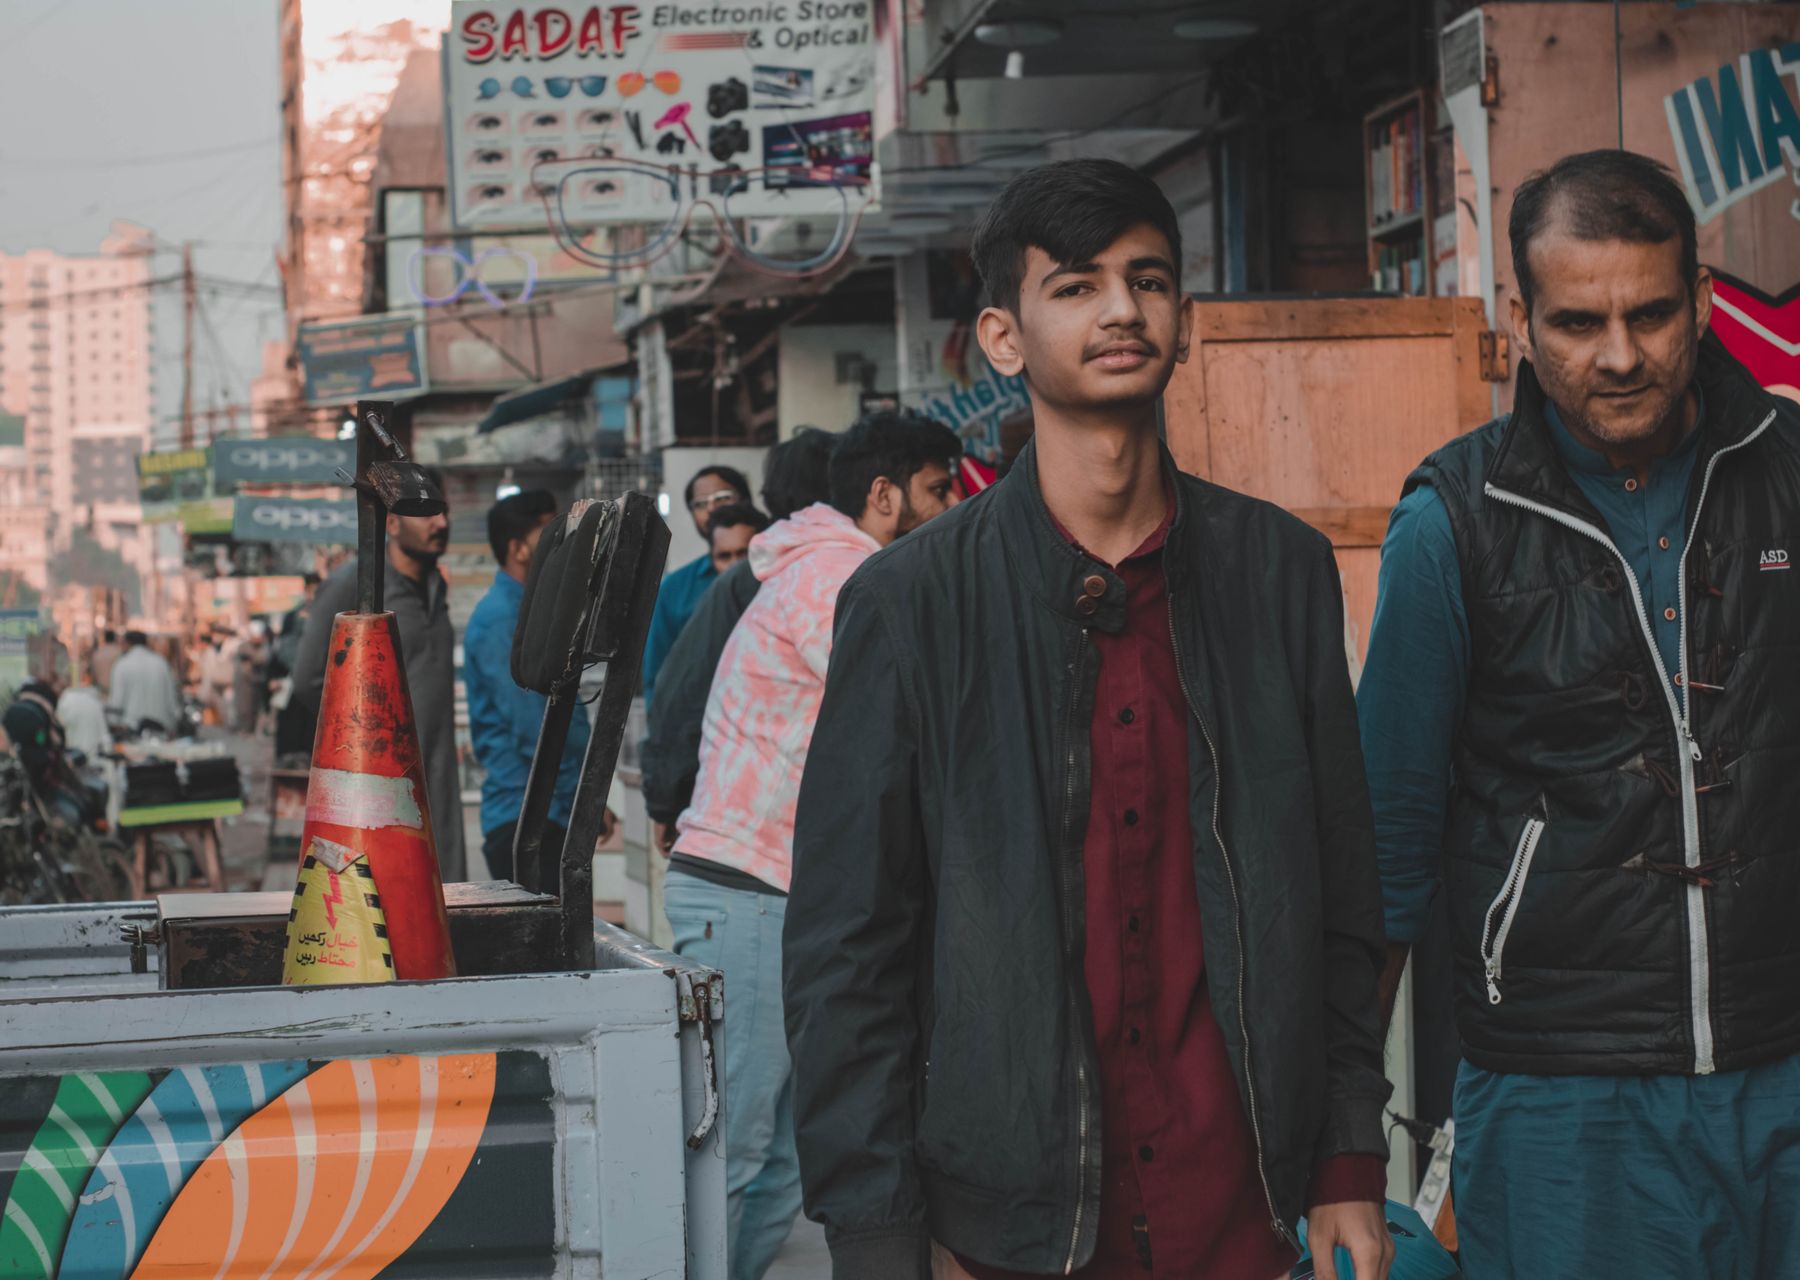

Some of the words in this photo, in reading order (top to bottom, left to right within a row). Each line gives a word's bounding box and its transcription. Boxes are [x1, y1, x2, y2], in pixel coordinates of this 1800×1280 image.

[652, 3, 786, 28] Electronic
[796, 0, 868, 21] Store
[462, 4, 640, 62] SADAF
[747, 31, 764, 49] &
[774, 24, 869, 51] Optical
[230, 446, 347, 470] oppo
[1760, 550, 1788, 563] ASD
